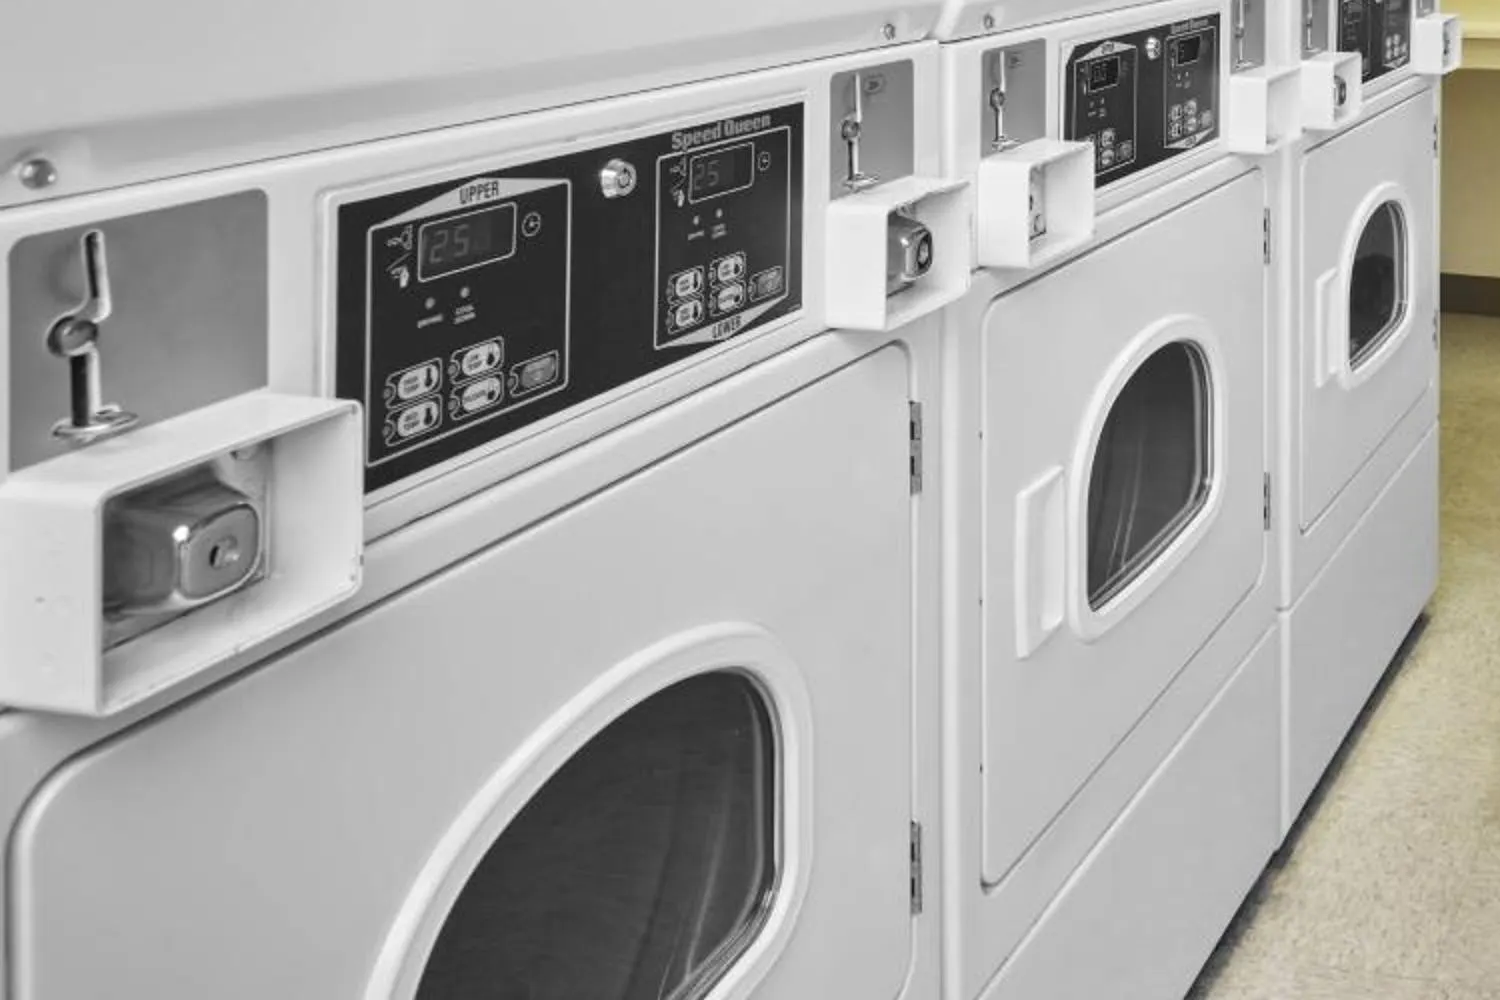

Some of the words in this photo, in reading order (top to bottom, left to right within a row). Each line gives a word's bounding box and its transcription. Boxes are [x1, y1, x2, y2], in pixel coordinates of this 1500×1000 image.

[671, 120, 721, 152] Speed
[723, 114, 772, 137] Queen
[458, 180, 500, 205] UPPER
